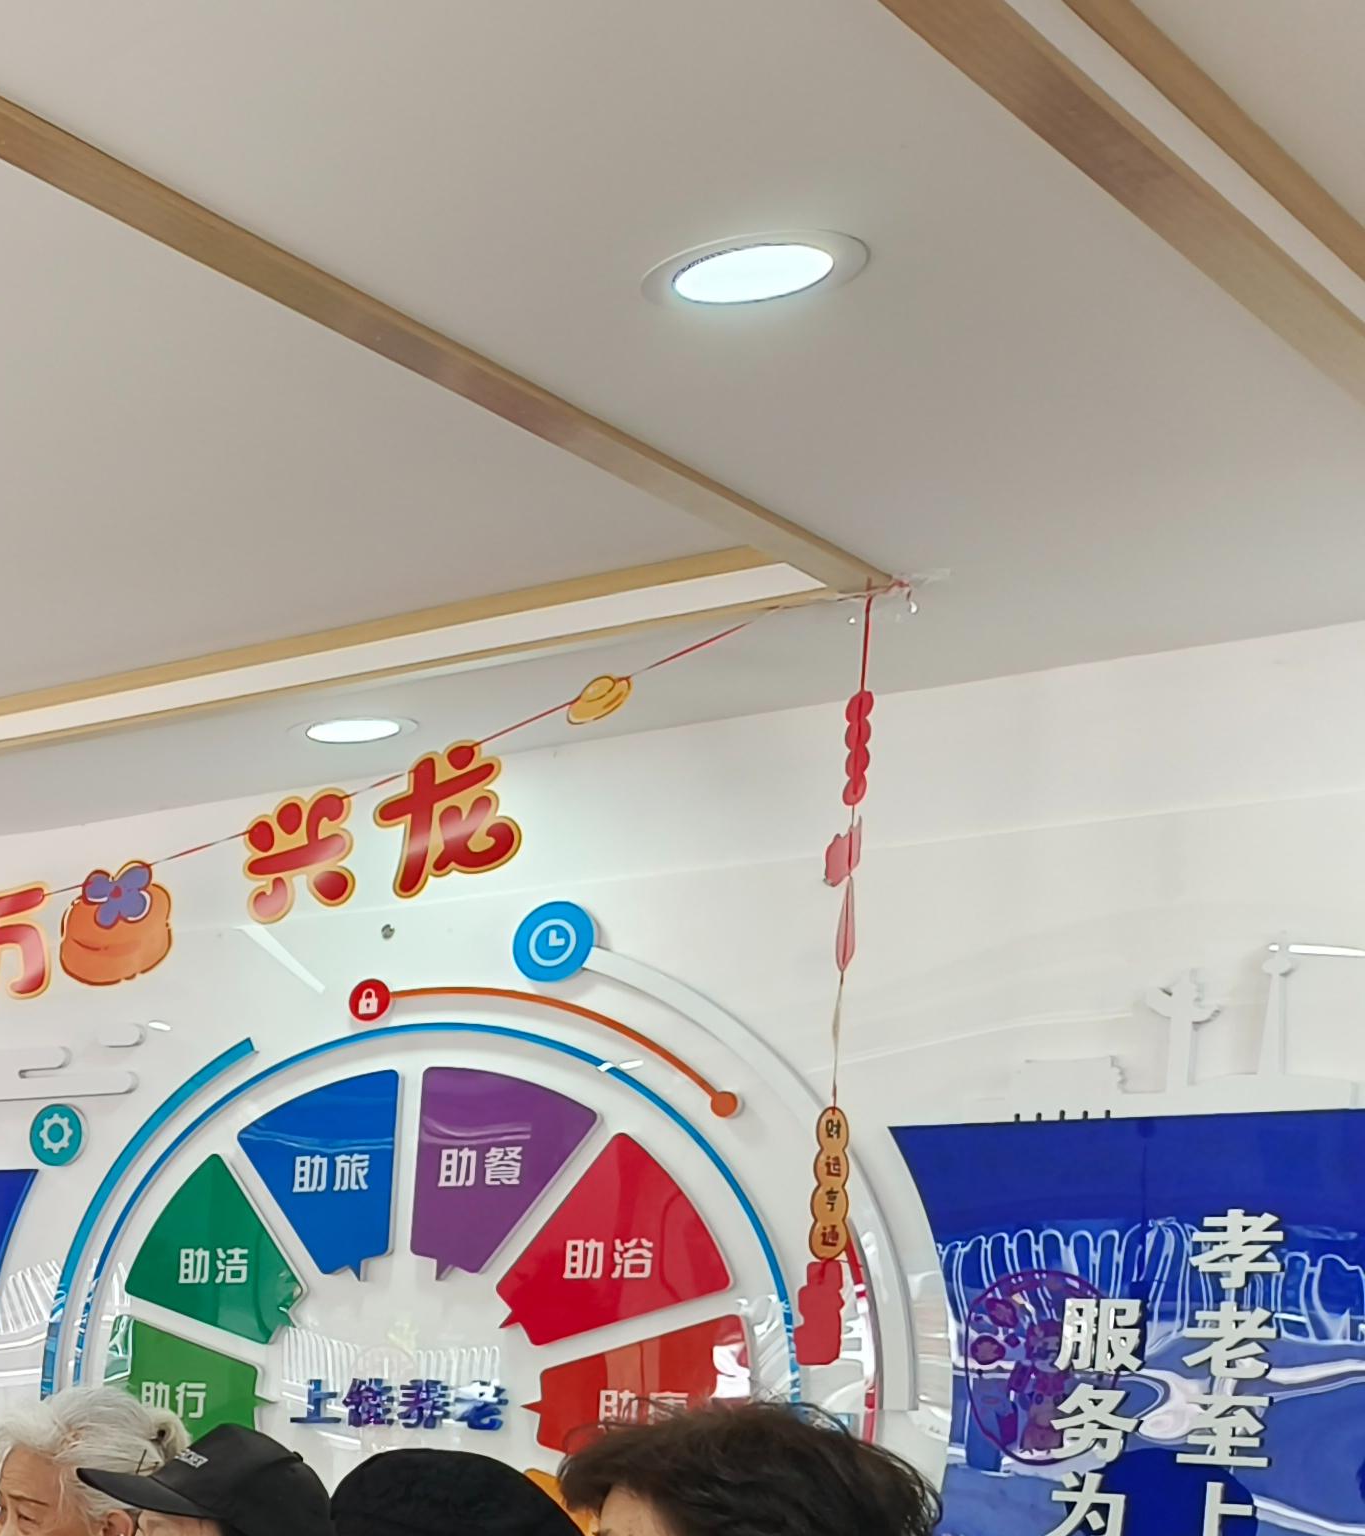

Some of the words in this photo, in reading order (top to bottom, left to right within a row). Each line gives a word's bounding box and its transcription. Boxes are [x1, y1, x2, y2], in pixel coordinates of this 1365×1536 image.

[292, 1154, 370, 1193] 助旅
[438, 1146, 524, 1188] 助餐
[178, 1247, 249, 1285] 助洁
[562, 1238, 654, 1280] 助浴
[141, 1382, 207, 1419] 助行
